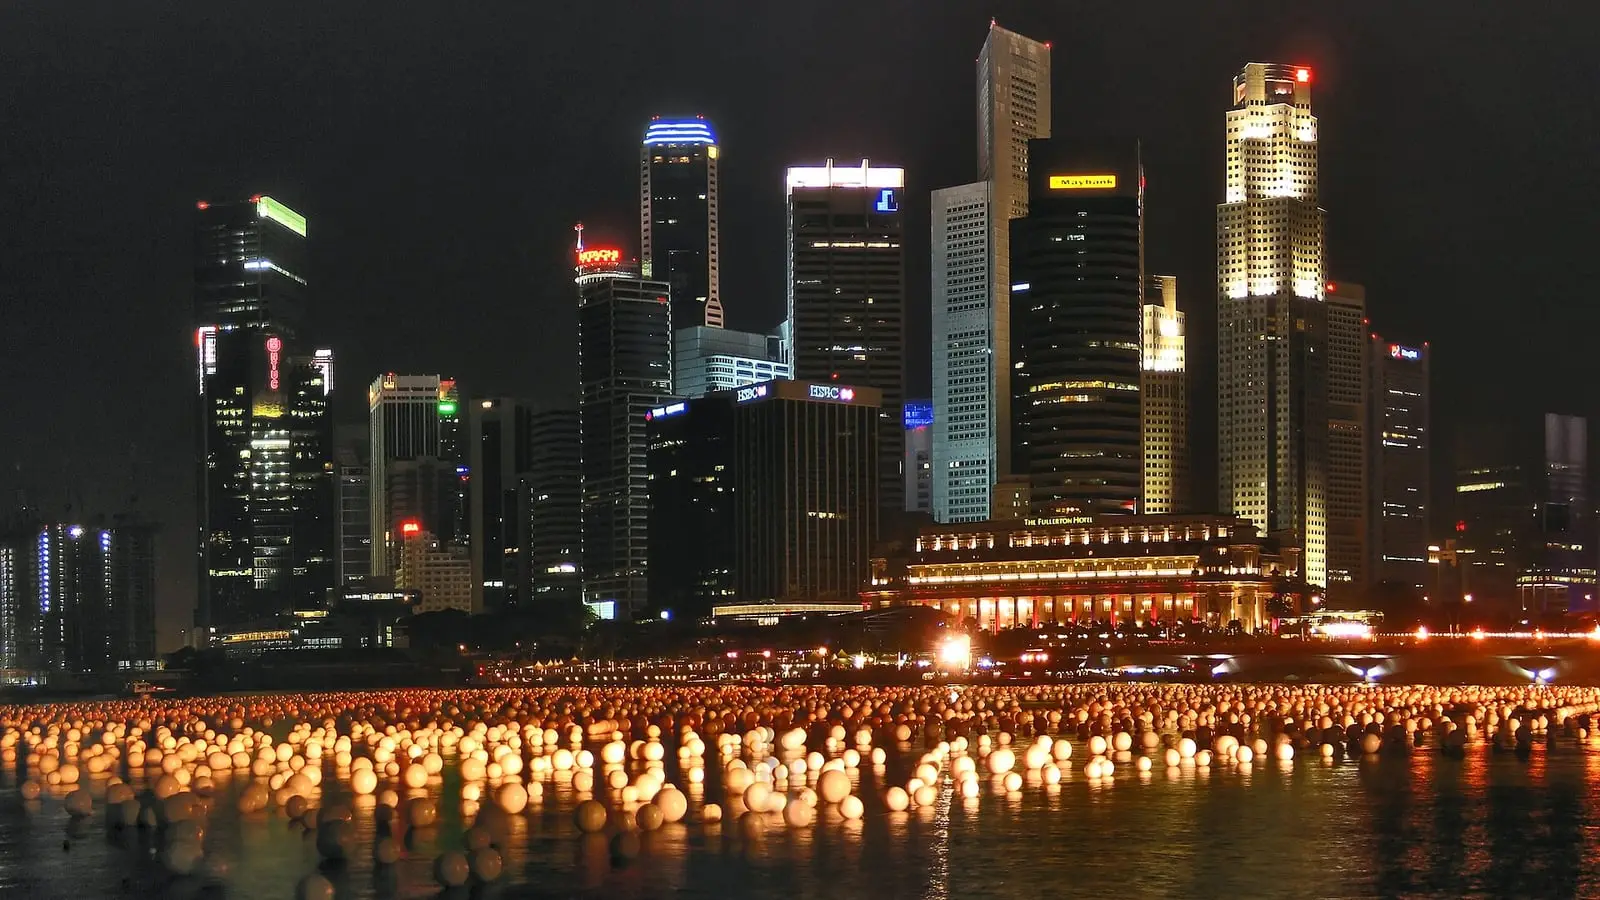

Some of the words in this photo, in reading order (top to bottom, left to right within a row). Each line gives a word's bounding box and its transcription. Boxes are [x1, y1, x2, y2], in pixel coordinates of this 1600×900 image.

[737, 386, 758, 402] HSBC
[810, 384, 840, 399] HSBC
[1024, 518, 1036, 526] THE
[1073, 516, 1093, 524] HOTEL
